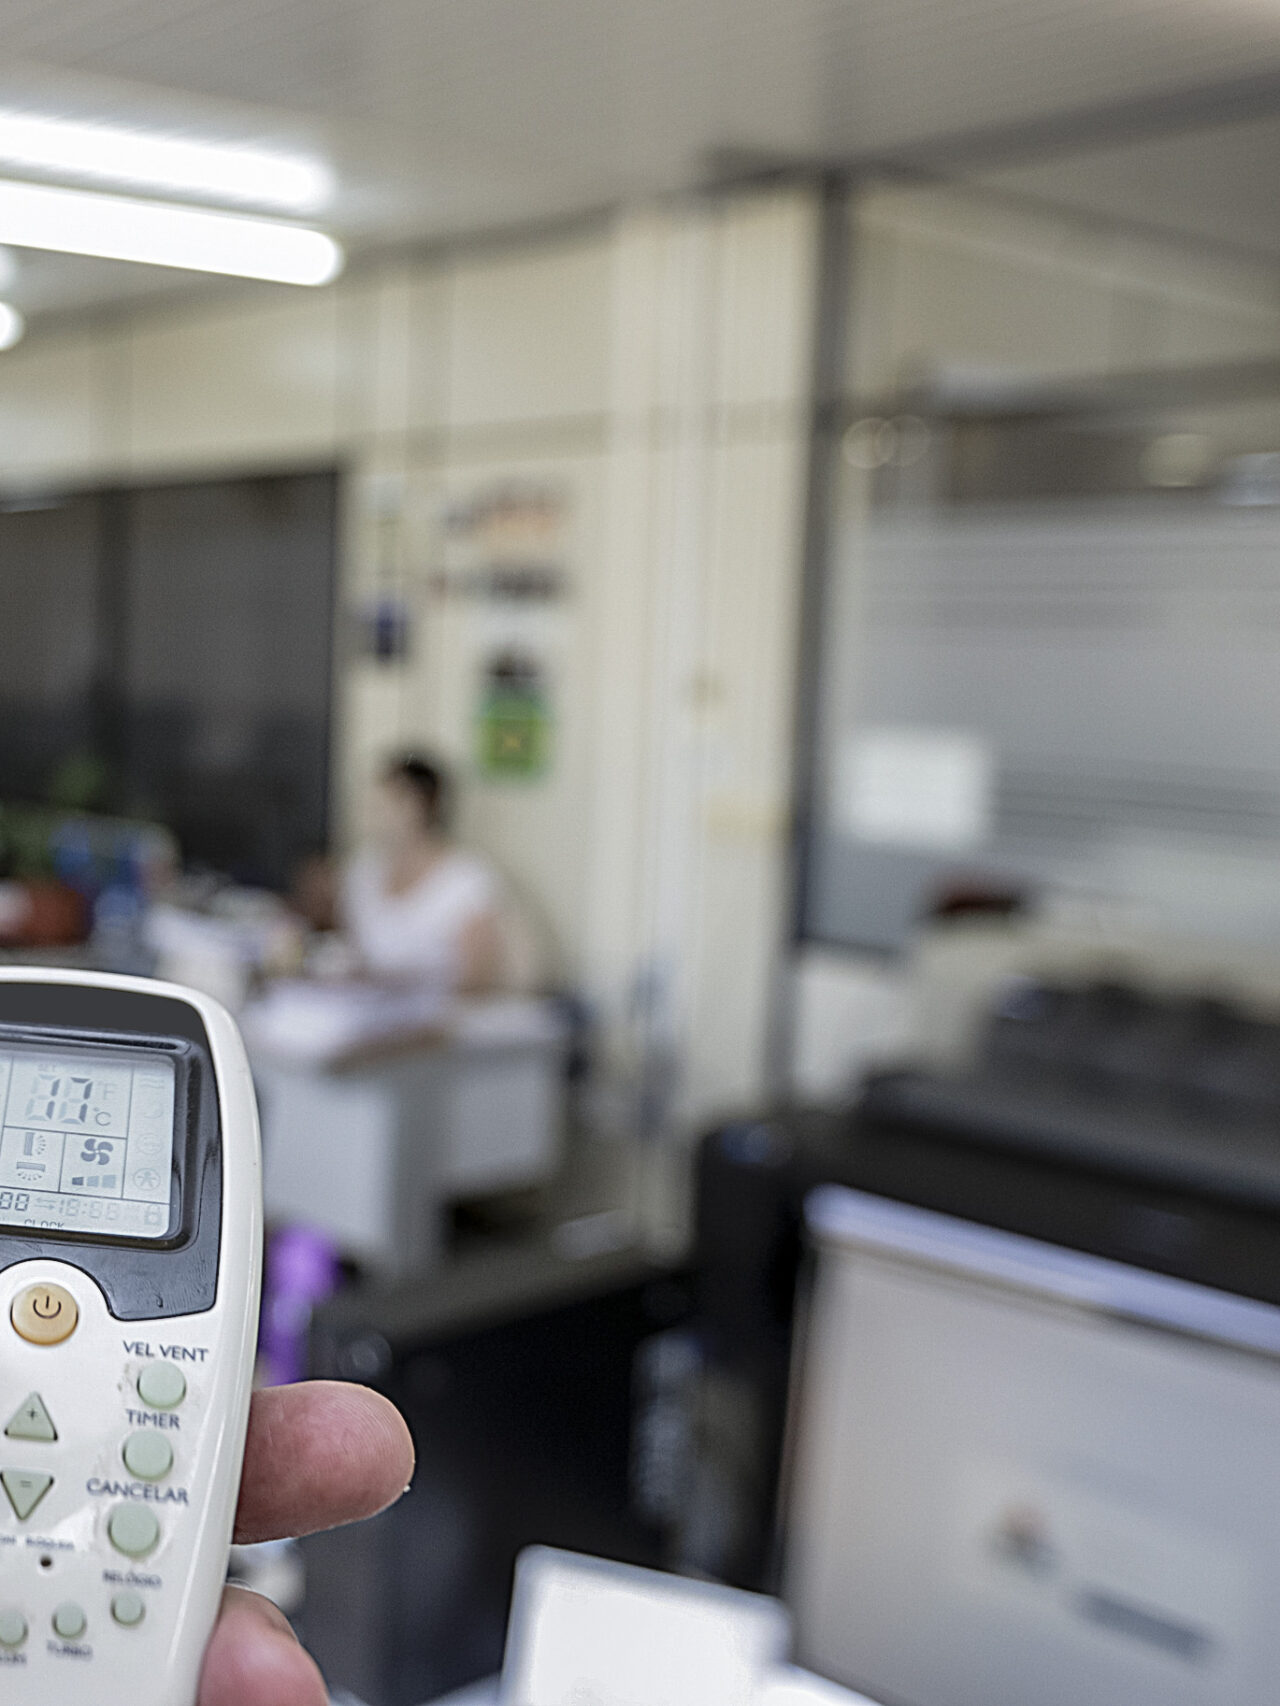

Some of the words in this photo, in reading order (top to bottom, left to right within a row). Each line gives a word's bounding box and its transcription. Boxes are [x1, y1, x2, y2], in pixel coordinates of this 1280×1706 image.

[45, 1076, 94, 1123] 17
[122, 1340, 154, 1358] VEL
[159, 1344, 209, 1363] VENT
[125, 1408, 181, 1429] TIMER
[85, 1477, 189, 1506] CANCELAR
